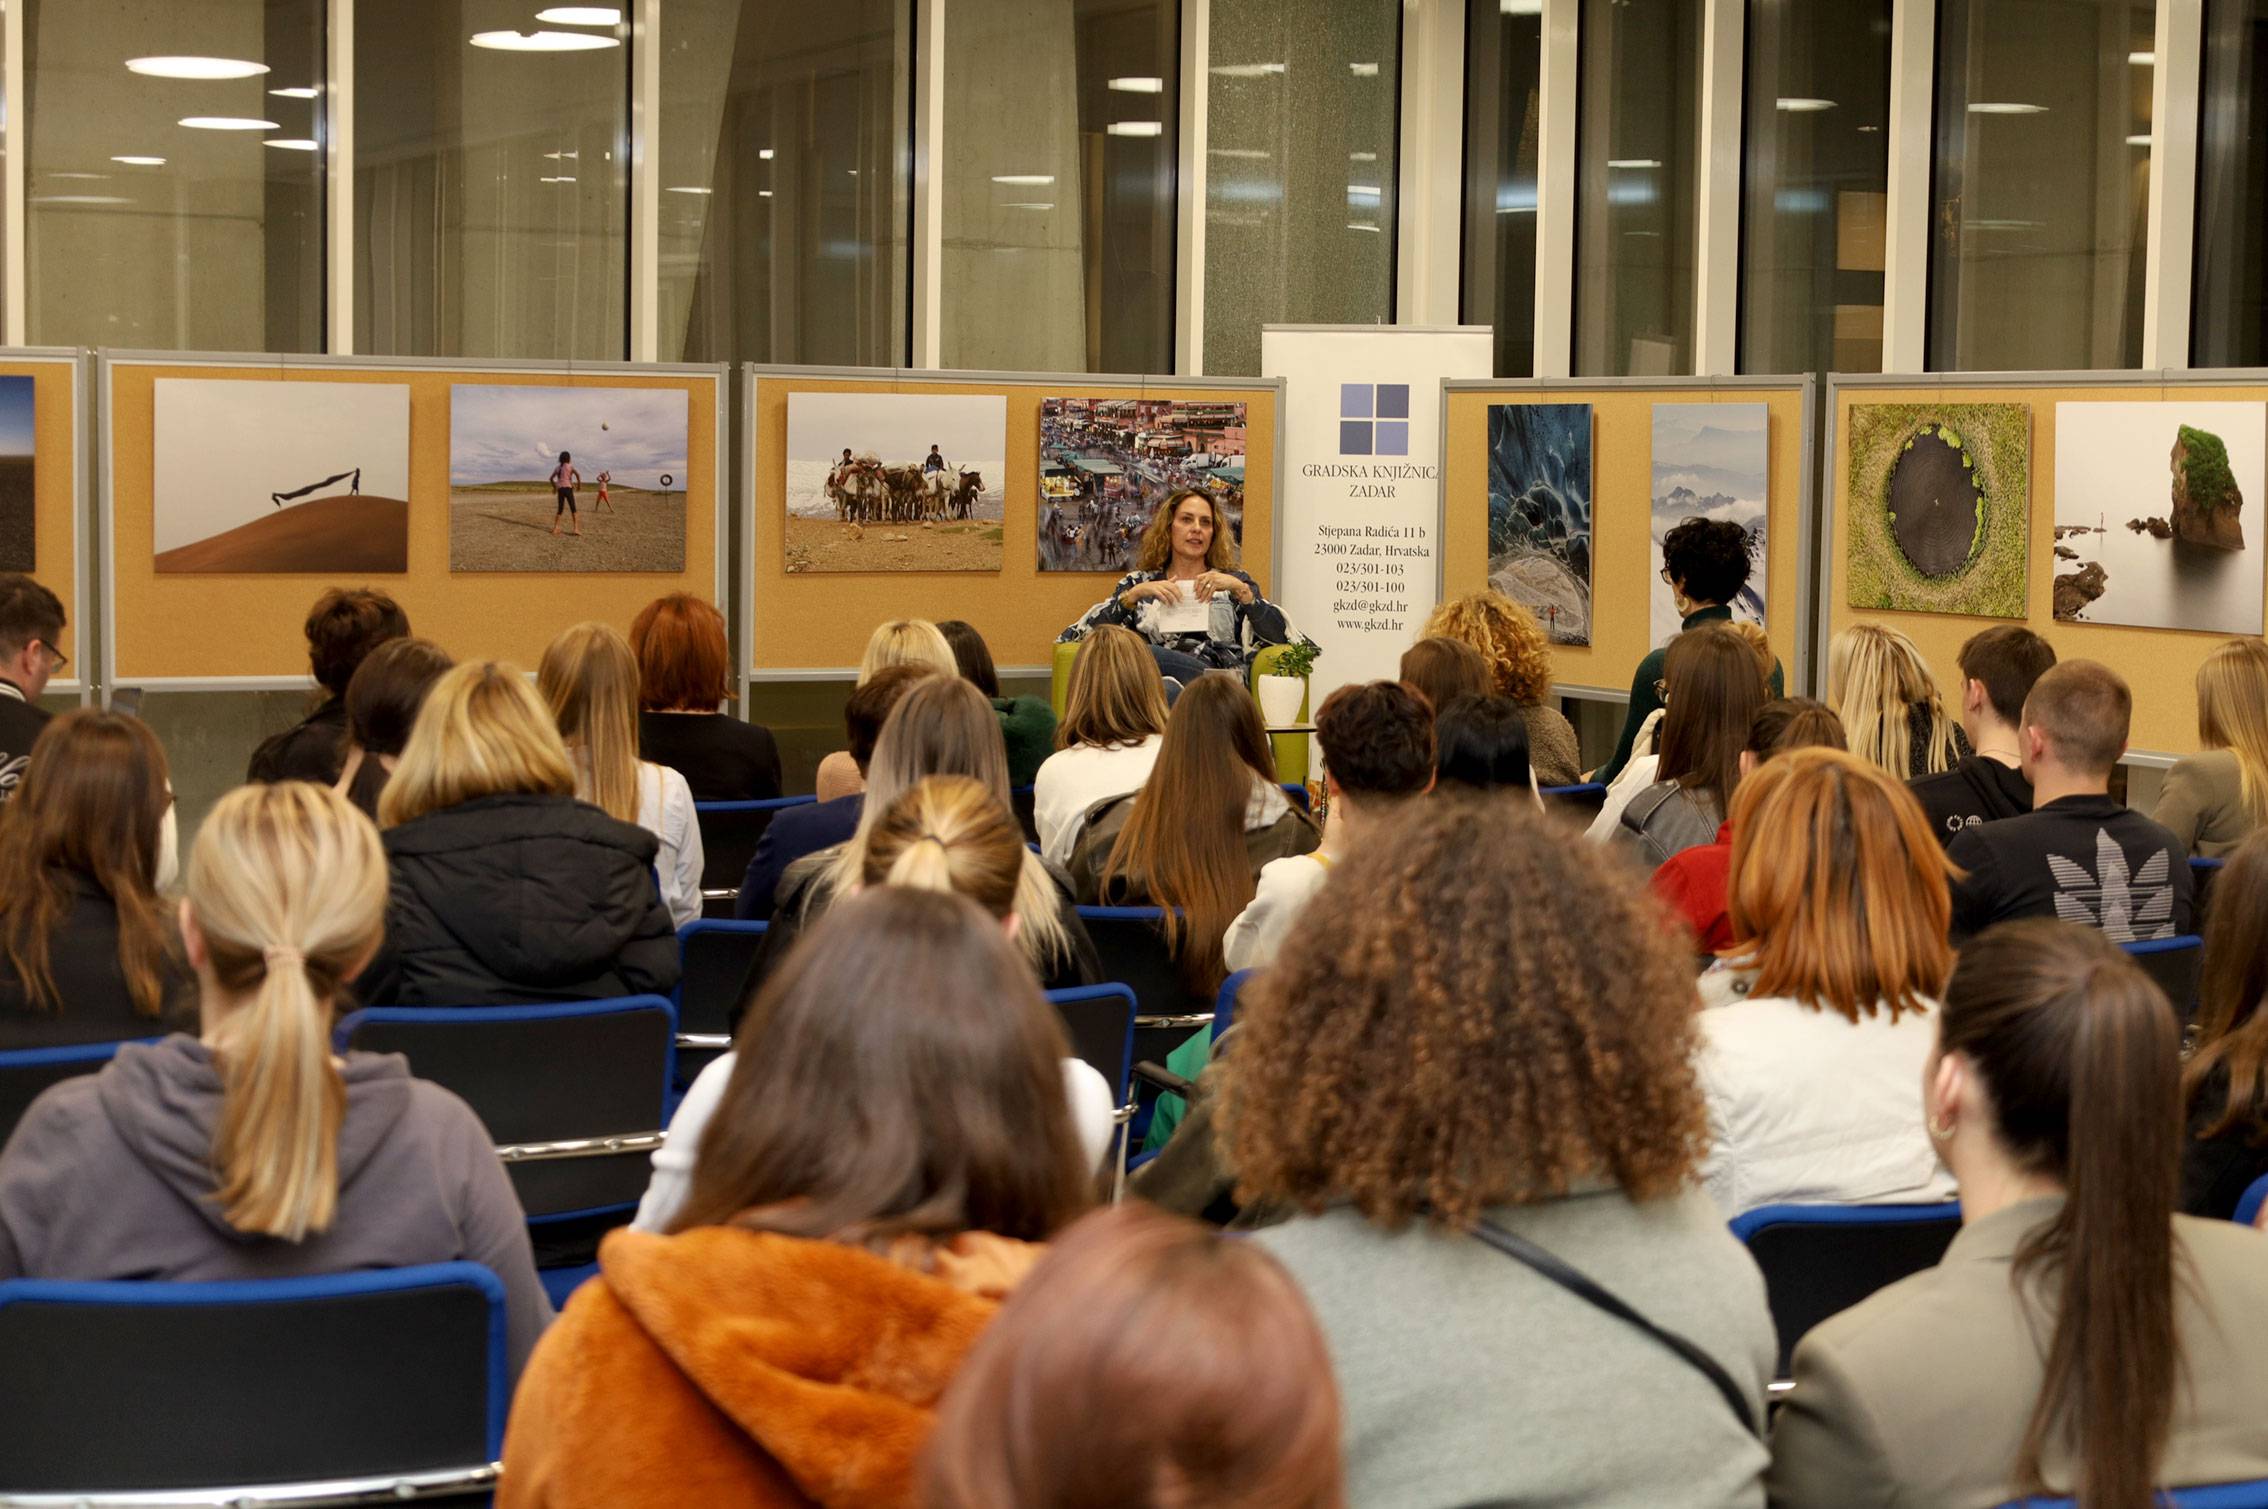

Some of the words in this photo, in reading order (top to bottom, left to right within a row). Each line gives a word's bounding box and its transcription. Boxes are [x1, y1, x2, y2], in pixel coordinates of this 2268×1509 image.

[1302, 464, 1368, 478] GRADSKA
[1349, 485, 1396, 498] ZADAR
[1318, 525, 1361, 539] Stjepana
[1365, 525, 1399, 538] Radića
[1404, 527, 1414, 538] 11
[1419, 526, 1426, 538] b
[1314, 543, 1347, 555] 23000
[1349, 544, 1382, 557] Zadar,
[1385, 545, 1430, 557] Hrvatska
[1336, 562, 1404, 576] 023/301-103
[1336, 580, 1405, 593] 023/301-100
[1333, 599, 1408, 614] gkzd@gkzd.hr
[1337, 618, 1404, 632] www.gkzd.hr
